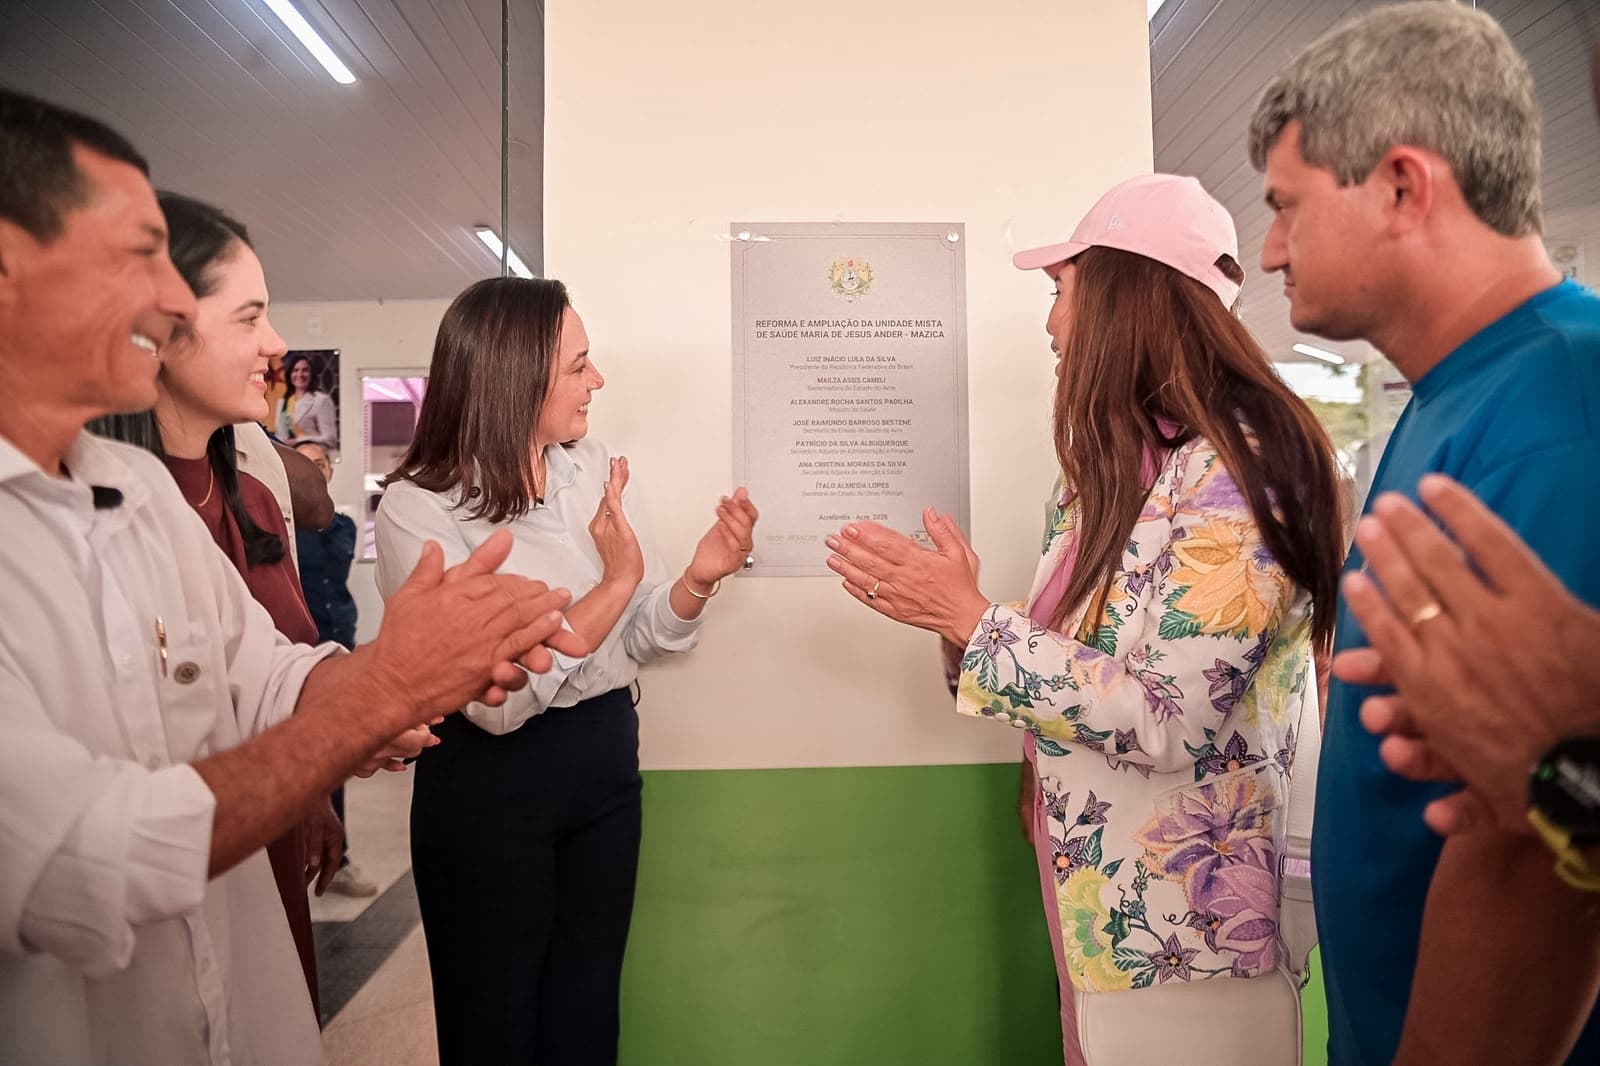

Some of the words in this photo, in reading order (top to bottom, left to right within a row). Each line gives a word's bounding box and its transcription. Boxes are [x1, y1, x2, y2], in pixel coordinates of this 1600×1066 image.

[755, 320, 798, 328] REFORMA
[800, 320, 806, 328] E
[807, 318, 859, 329] AMPLIAÇÃO
[861, 320, 873, 328] DA
[875, 320, 913, 328] UNIDADE
[914, 320, 943, 328] MISTA
[756, 330, 768, 338] DE
[769, 329, 799, 338] SAÚDE
[800, 330, 829, 338] MARIA
[831, 330, 842, 338] DE
[844, 330, 872, 338] JESUS
[874, 330, 903, 338] ANDER
[910, 330, 944, 338] MAZICA
[795, 440, 827, 448] PATRÍCIO
[828, 440, 838, 448] DA
[839, 440, 859, 448] SILVA
[860, 440, 909, 448] ALBUQUERQUE
